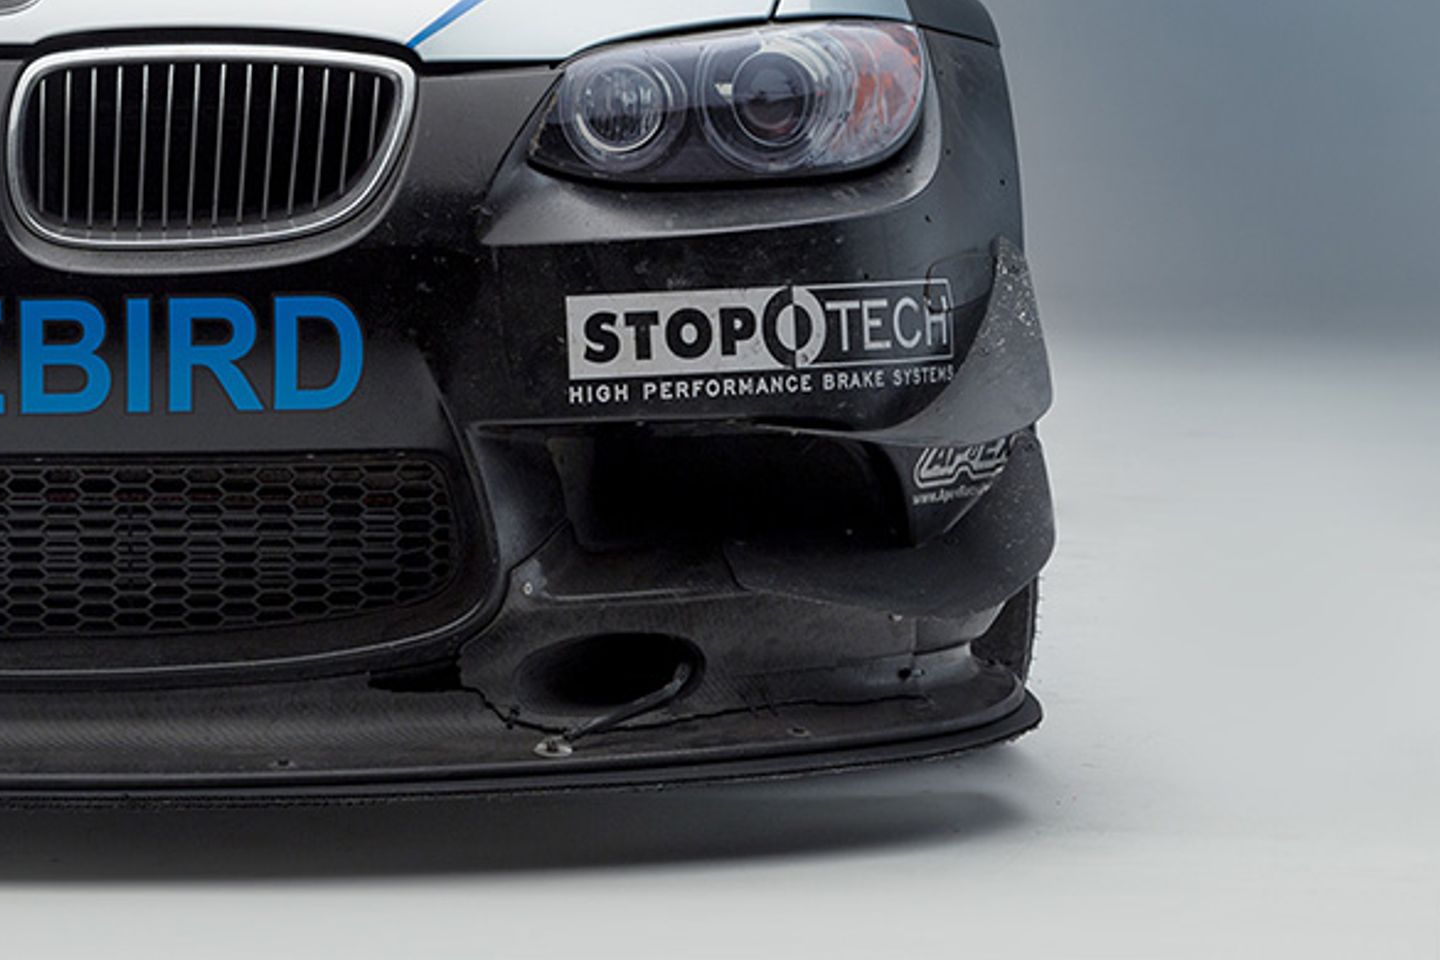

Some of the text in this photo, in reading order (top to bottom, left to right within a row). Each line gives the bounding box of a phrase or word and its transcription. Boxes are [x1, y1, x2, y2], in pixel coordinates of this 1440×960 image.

[568, 363, 955, 403] HIGH PERFORMANCE BRAKE SYSTEMS
